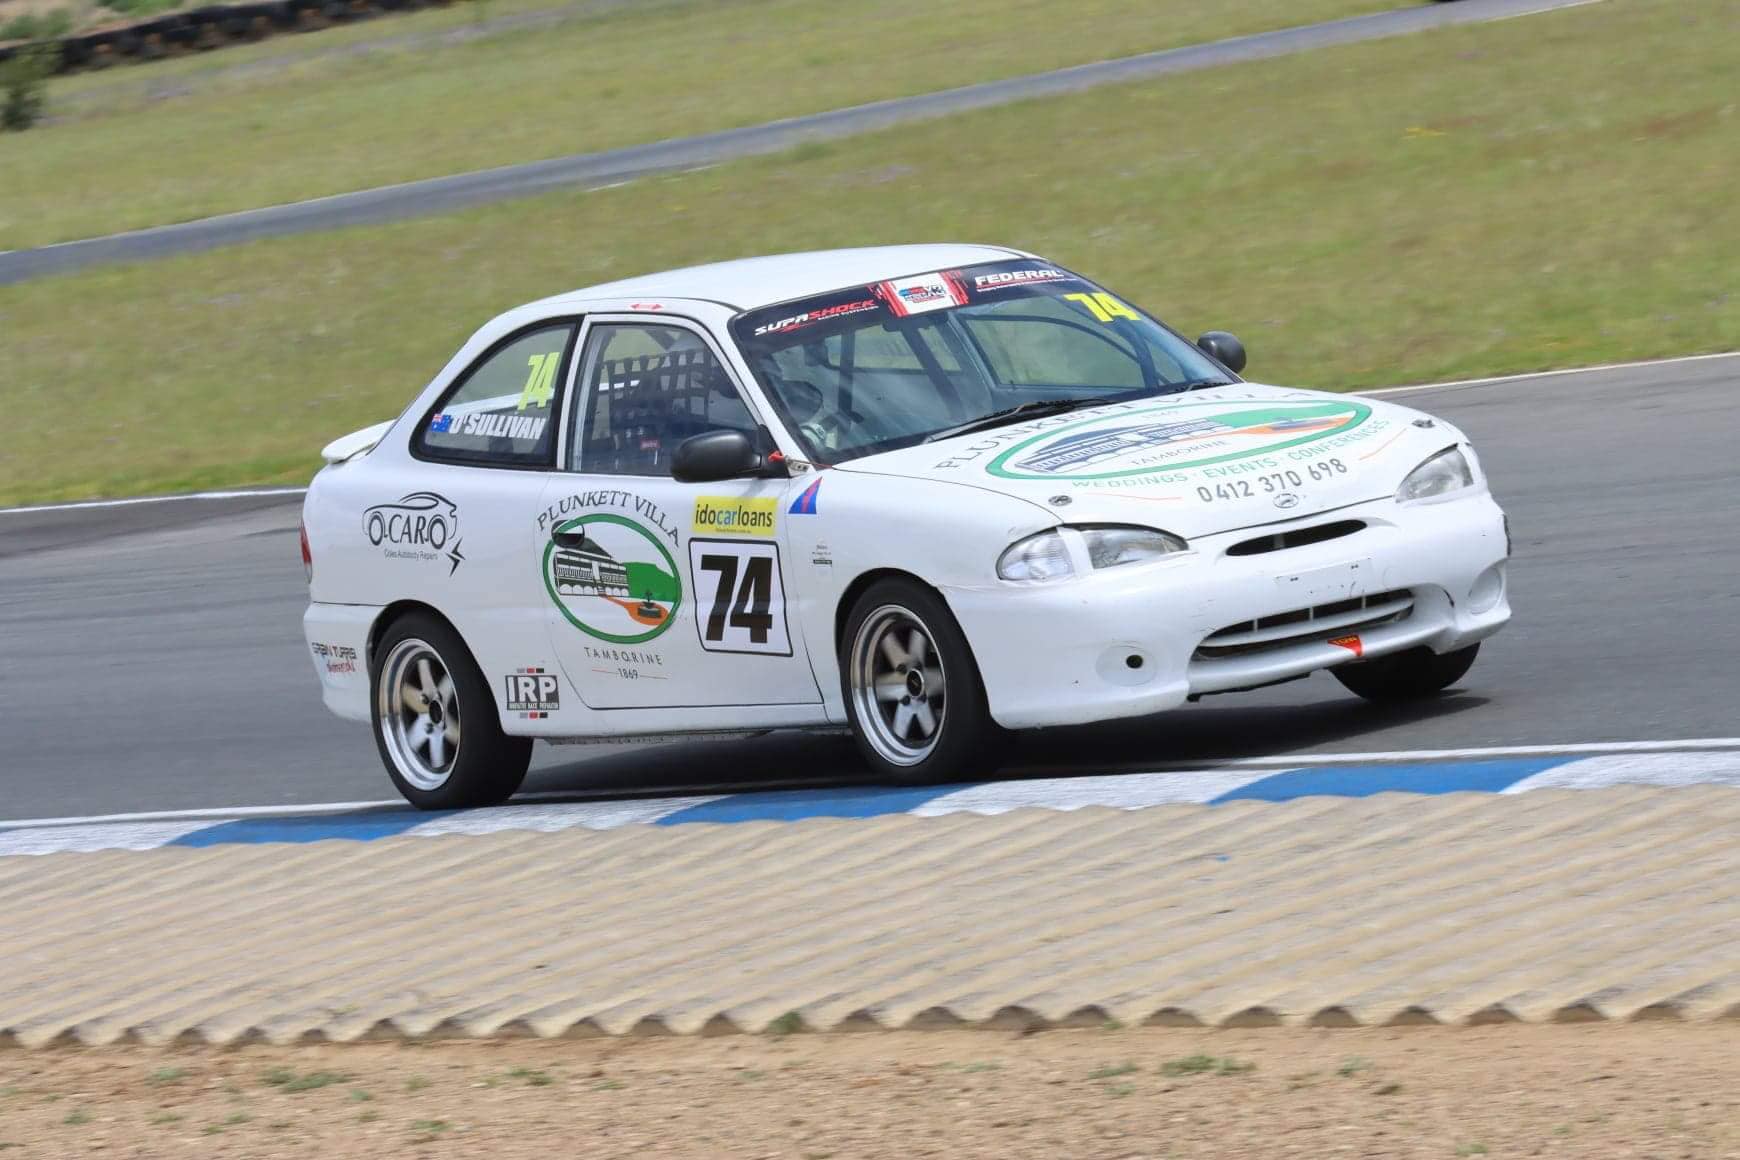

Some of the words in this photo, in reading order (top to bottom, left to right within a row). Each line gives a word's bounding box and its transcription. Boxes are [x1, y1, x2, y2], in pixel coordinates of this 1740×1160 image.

[974, 269, 1065, 287] FEDERAL
[754, 299, 876, 336] SUPASHOCK
[1063, 292, 1141, 322] 74
[517, 351, 560, 411] 74
[448, 412, 546, 440] O'SULLIVAN
[1072, 472, 1189, 488] WEDDINGS
[1202, 457, 1278, 479] EVENTS
[1287, 419, 1391, 461] CONFERENCES
[1196, 480, 1255, 503] 0412
[1258, 470, 1303, 493] 370
[1308, 457, 1348, 482] 698
[537, 490, 632, 532] PLUNKETT
[635, 495, 680, 548] VILLA
[695, 503, 773, 528] idocarloans
[701, 554, 773, 644] 74
[583, 646, 664, 666] TAMBORINE
[617, 667, 639, 680] 1869
[507, 676, 557, 703] IRP
